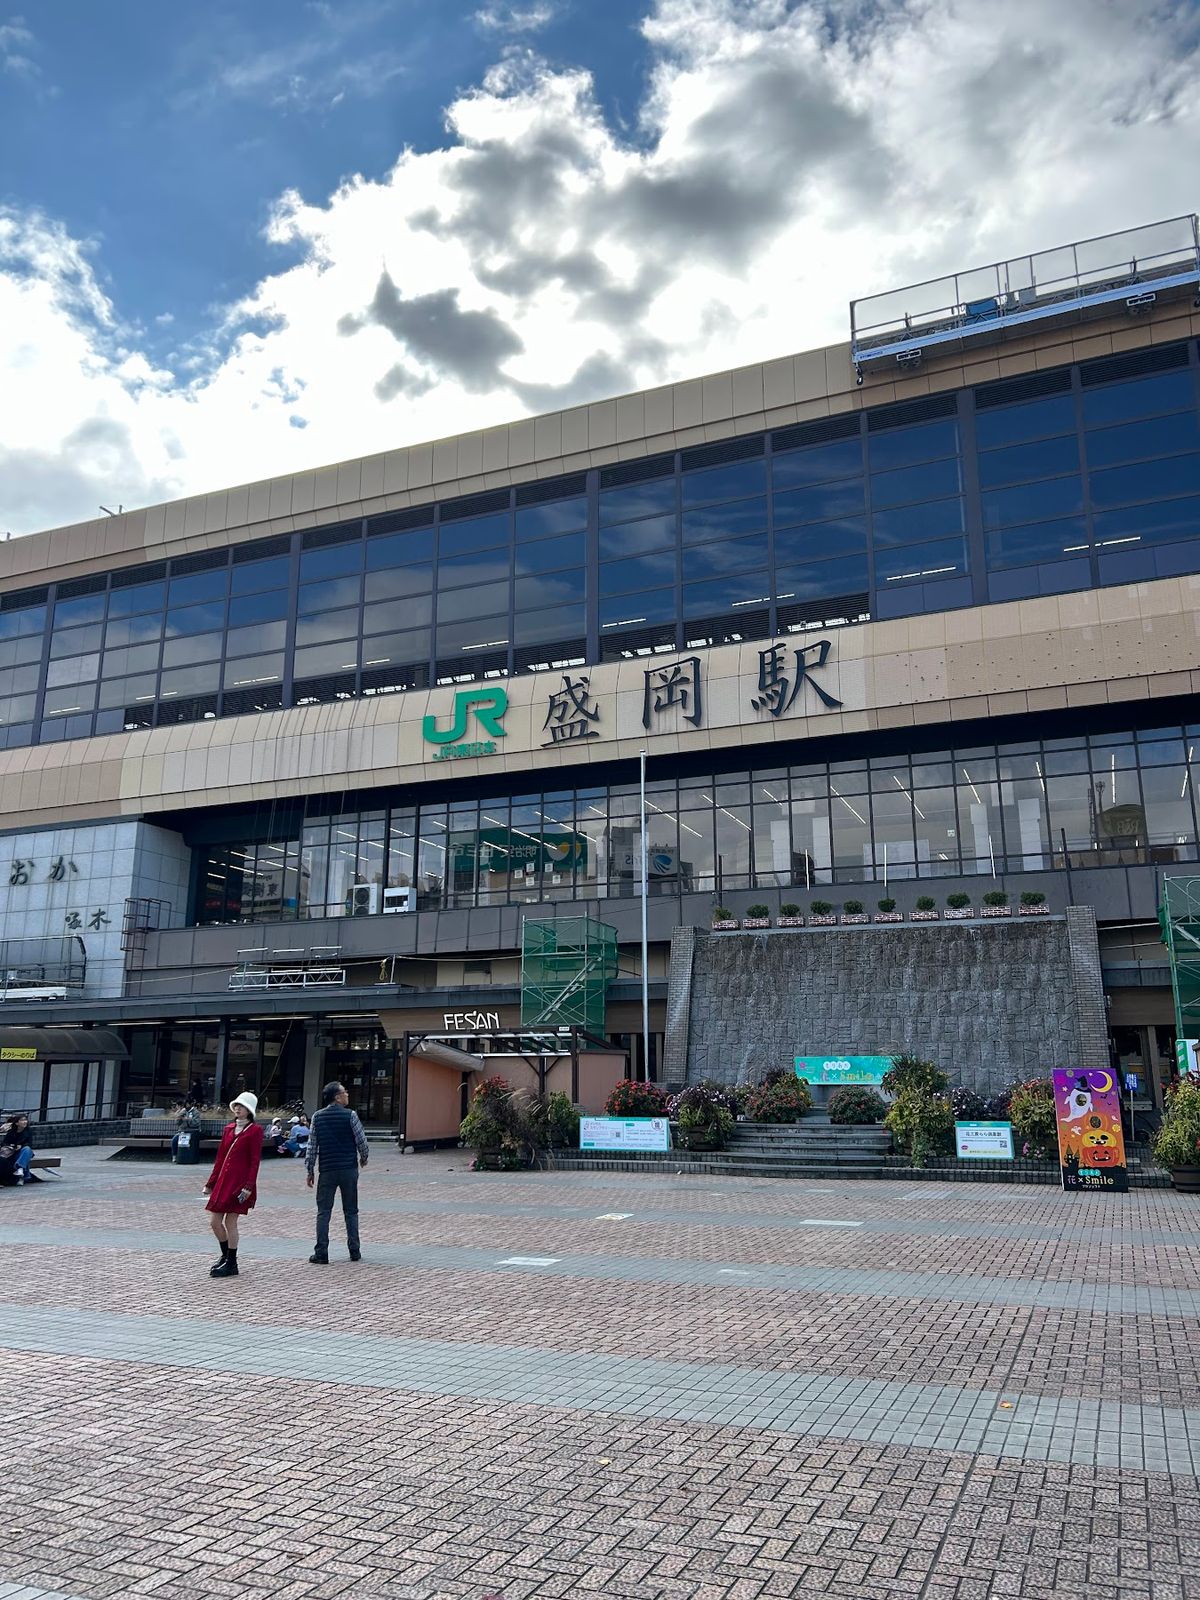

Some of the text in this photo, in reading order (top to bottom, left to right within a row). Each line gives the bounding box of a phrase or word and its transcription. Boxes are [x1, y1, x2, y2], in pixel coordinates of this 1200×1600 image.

[422, 687, 509, 744] JR
[540, 639, 844, 747] 盛岡駅
